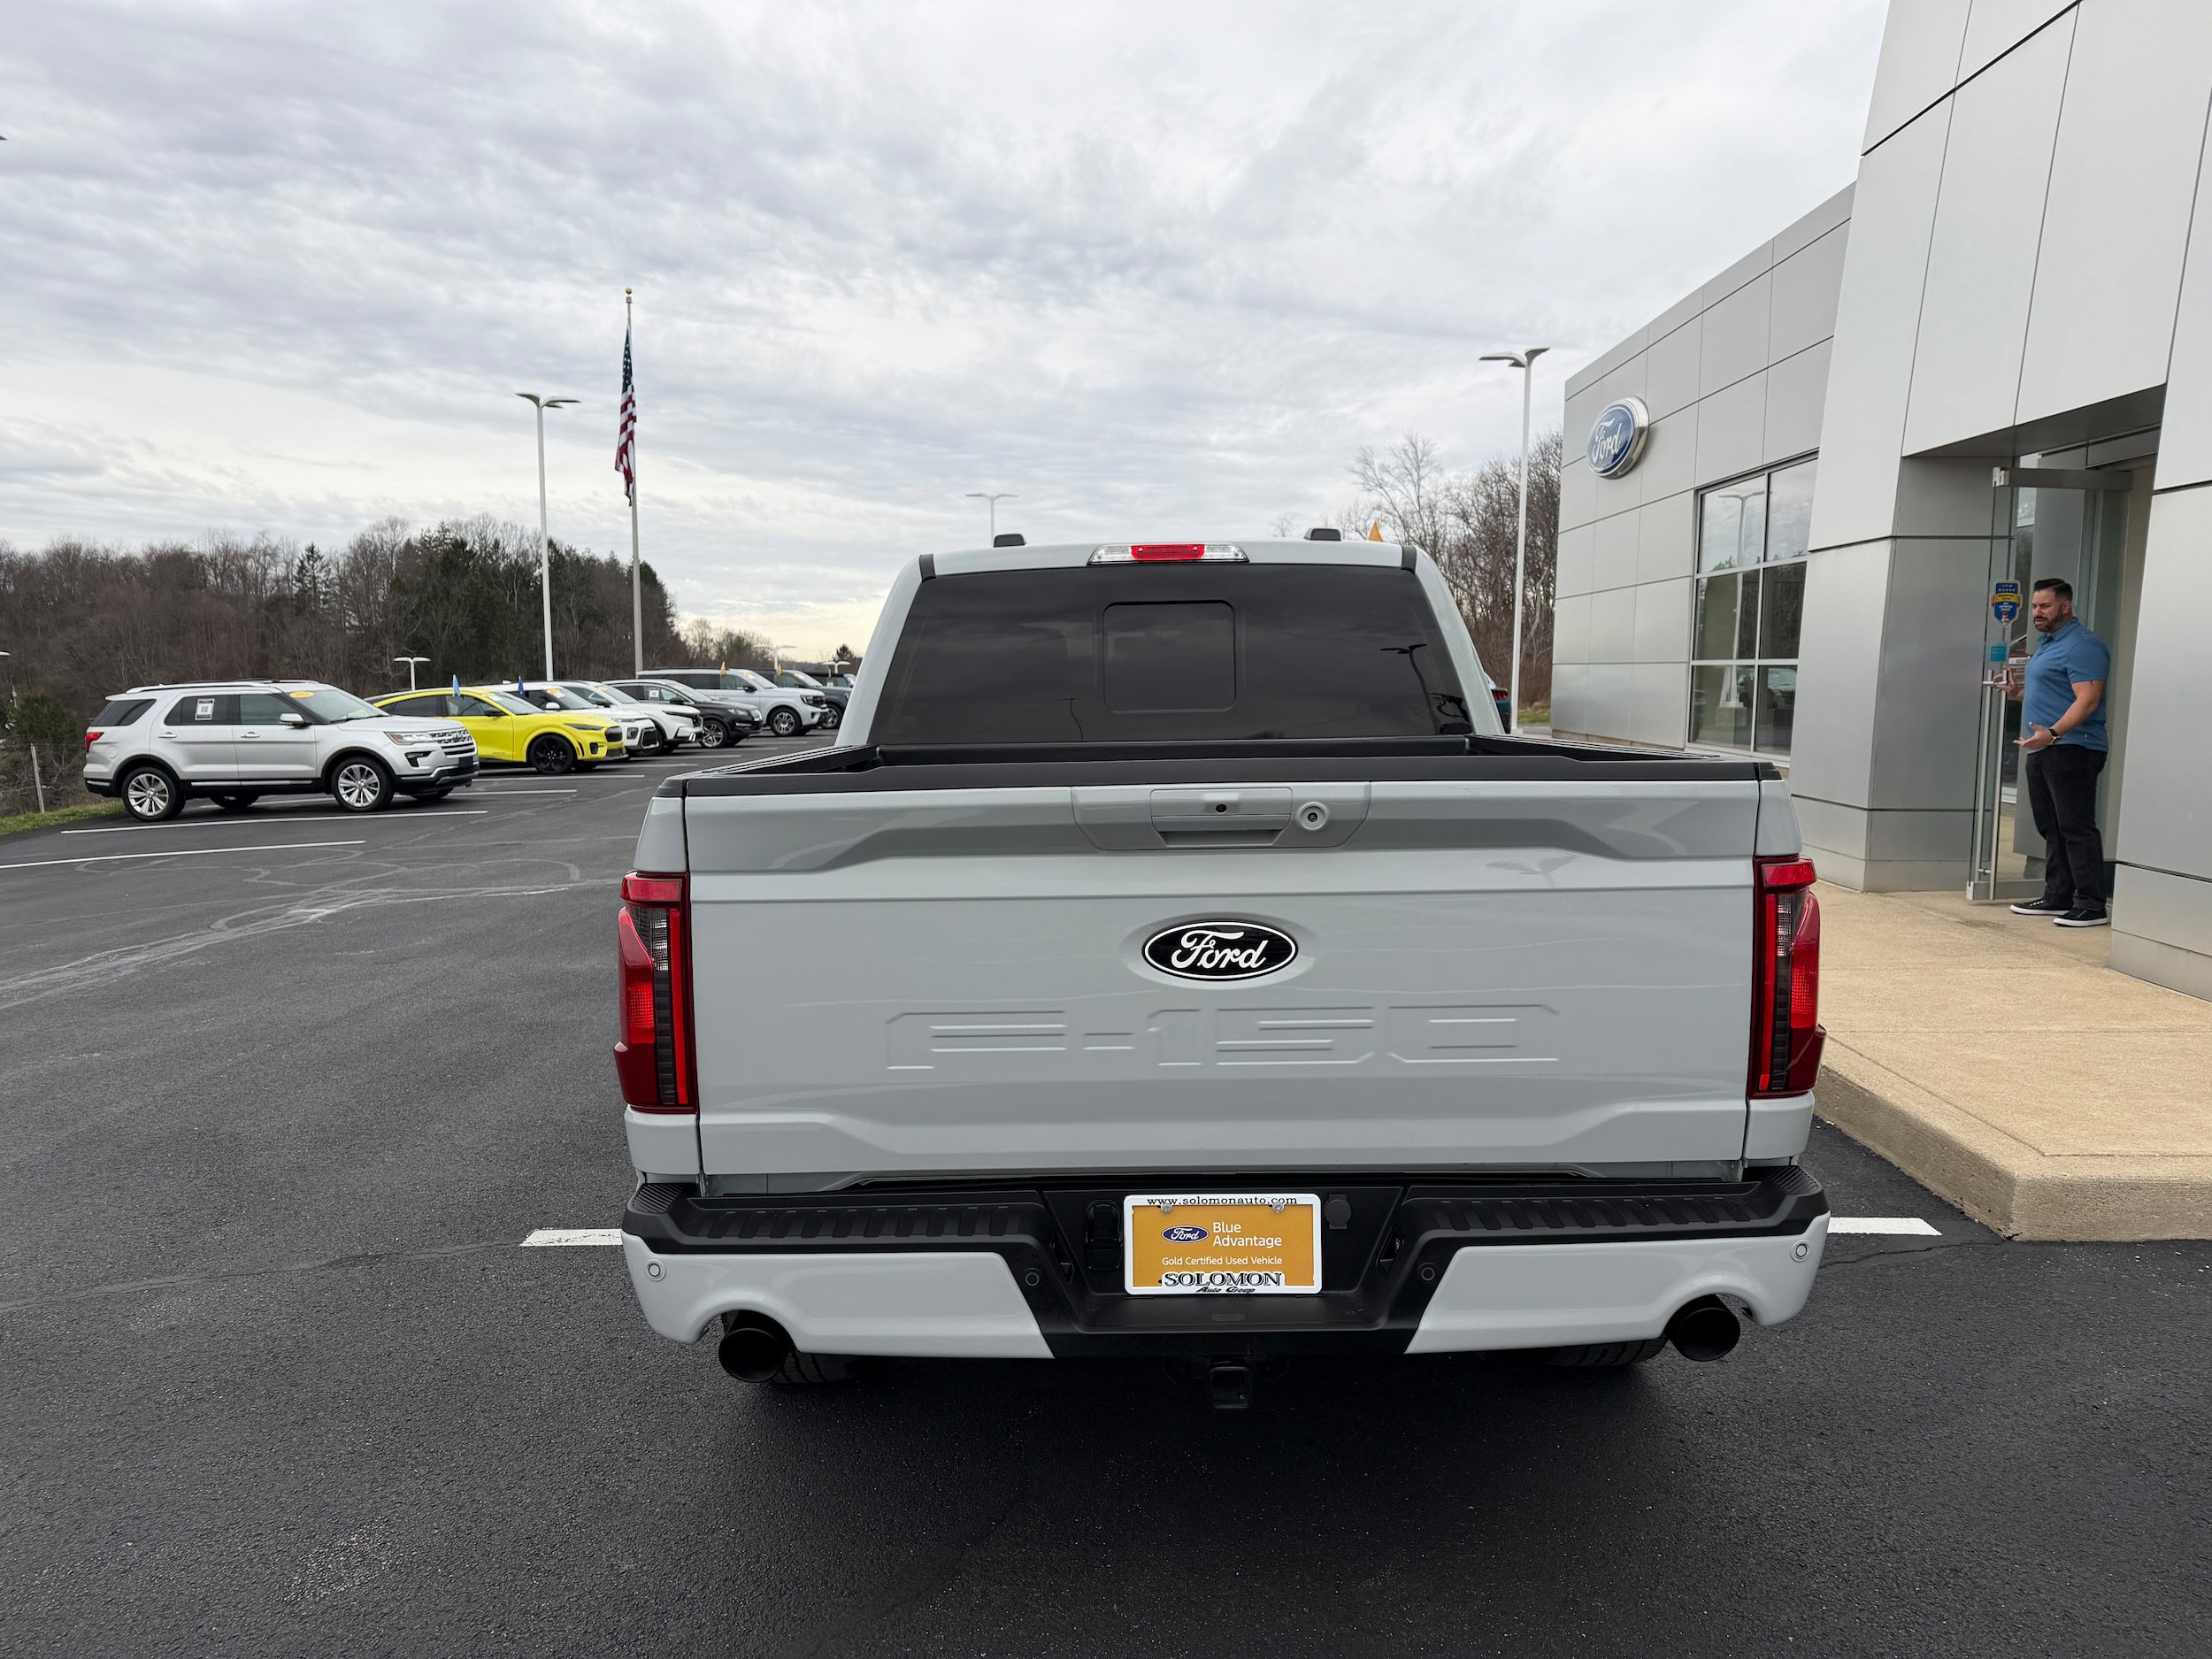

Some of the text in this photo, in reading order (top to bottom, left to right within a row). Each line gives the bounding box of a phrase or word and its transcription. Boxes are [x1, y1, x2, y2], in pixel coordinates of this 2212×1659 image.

[1592, 417, 1623, 464] Ford
[1171, 929, 1269, 969] Ford
[886, 1003, 1558, 1070] F-150
[1147, 1196, 1298, 1205] www.solomonauto.com
[1170, 1226, 1200, 1240] Ford
[1212, 1222, 1241, 1233] Blue
[1212, 1235, 1282, 1248] Advantage
[1162, 1256, 1283, 1266] Gold Certified Used Vehicle
[1164, 1272, 1282, 1286] SOLOMON
